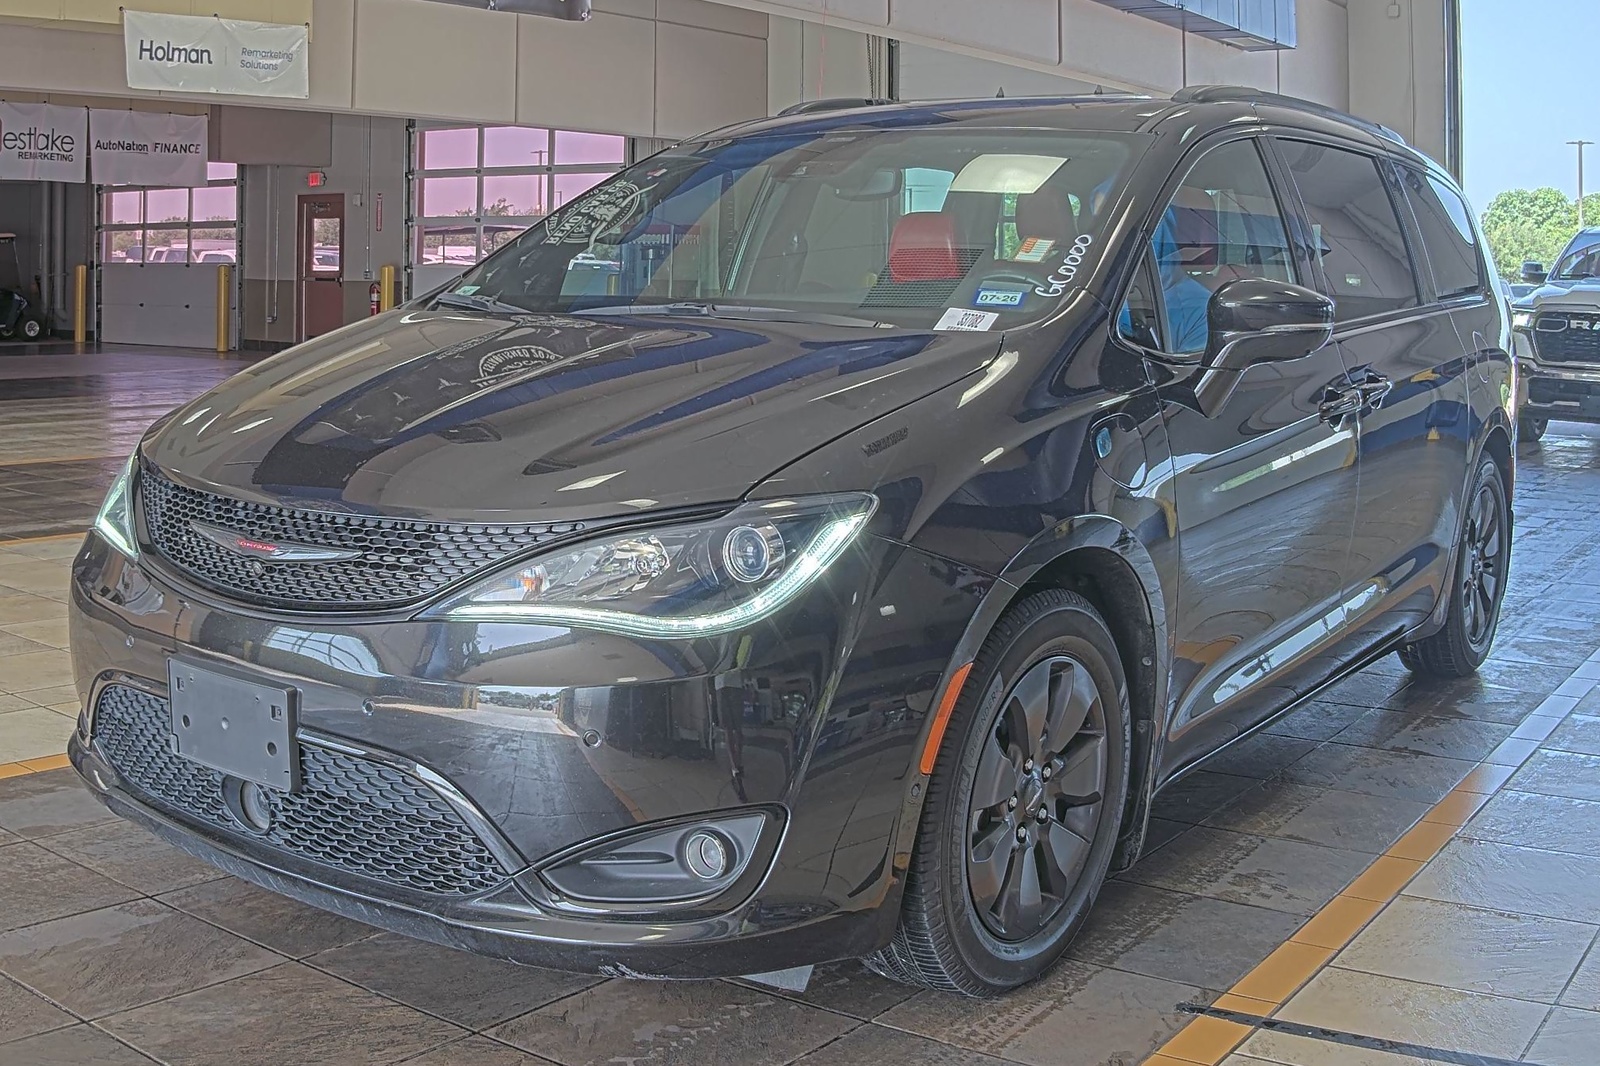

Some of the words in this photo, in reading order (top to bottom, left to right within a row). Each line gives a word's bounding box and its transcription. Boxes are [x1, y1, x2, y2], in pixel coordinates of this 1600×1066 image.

[139, 39, 213, 65] Holman
[241, 47, 293, 62] Remarketing
[240, 59, 279, 71] Solutions
[0, 126, 75, 153] estlake
[95, 139, 149, 153] AutoNation
[153, 142, 201, 155] FINANCE
[17, 151, 74, 162] REMARKETING
